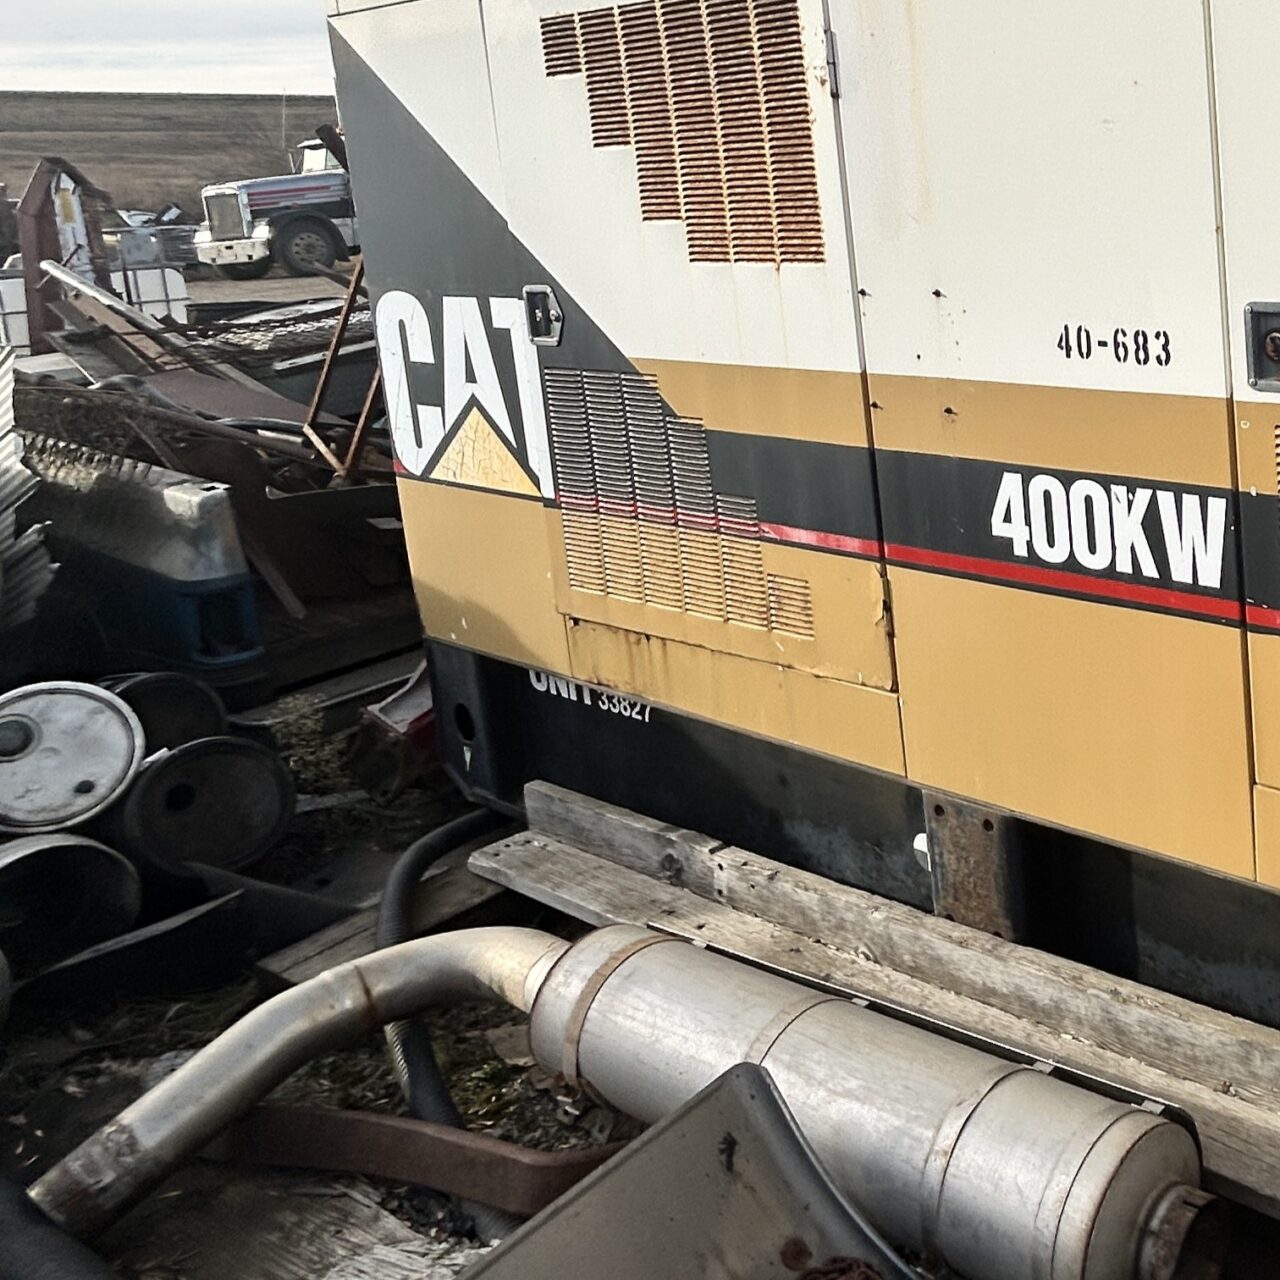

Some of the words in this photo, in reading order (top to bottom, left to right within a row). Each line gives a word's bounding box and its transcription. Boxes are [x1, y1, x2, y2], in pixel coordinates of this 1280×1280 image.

[376, 290, 555, 499] CAT
[1057, 324, 1171, 366] 40-683
[991, 471, 1227, 589] 400KW
